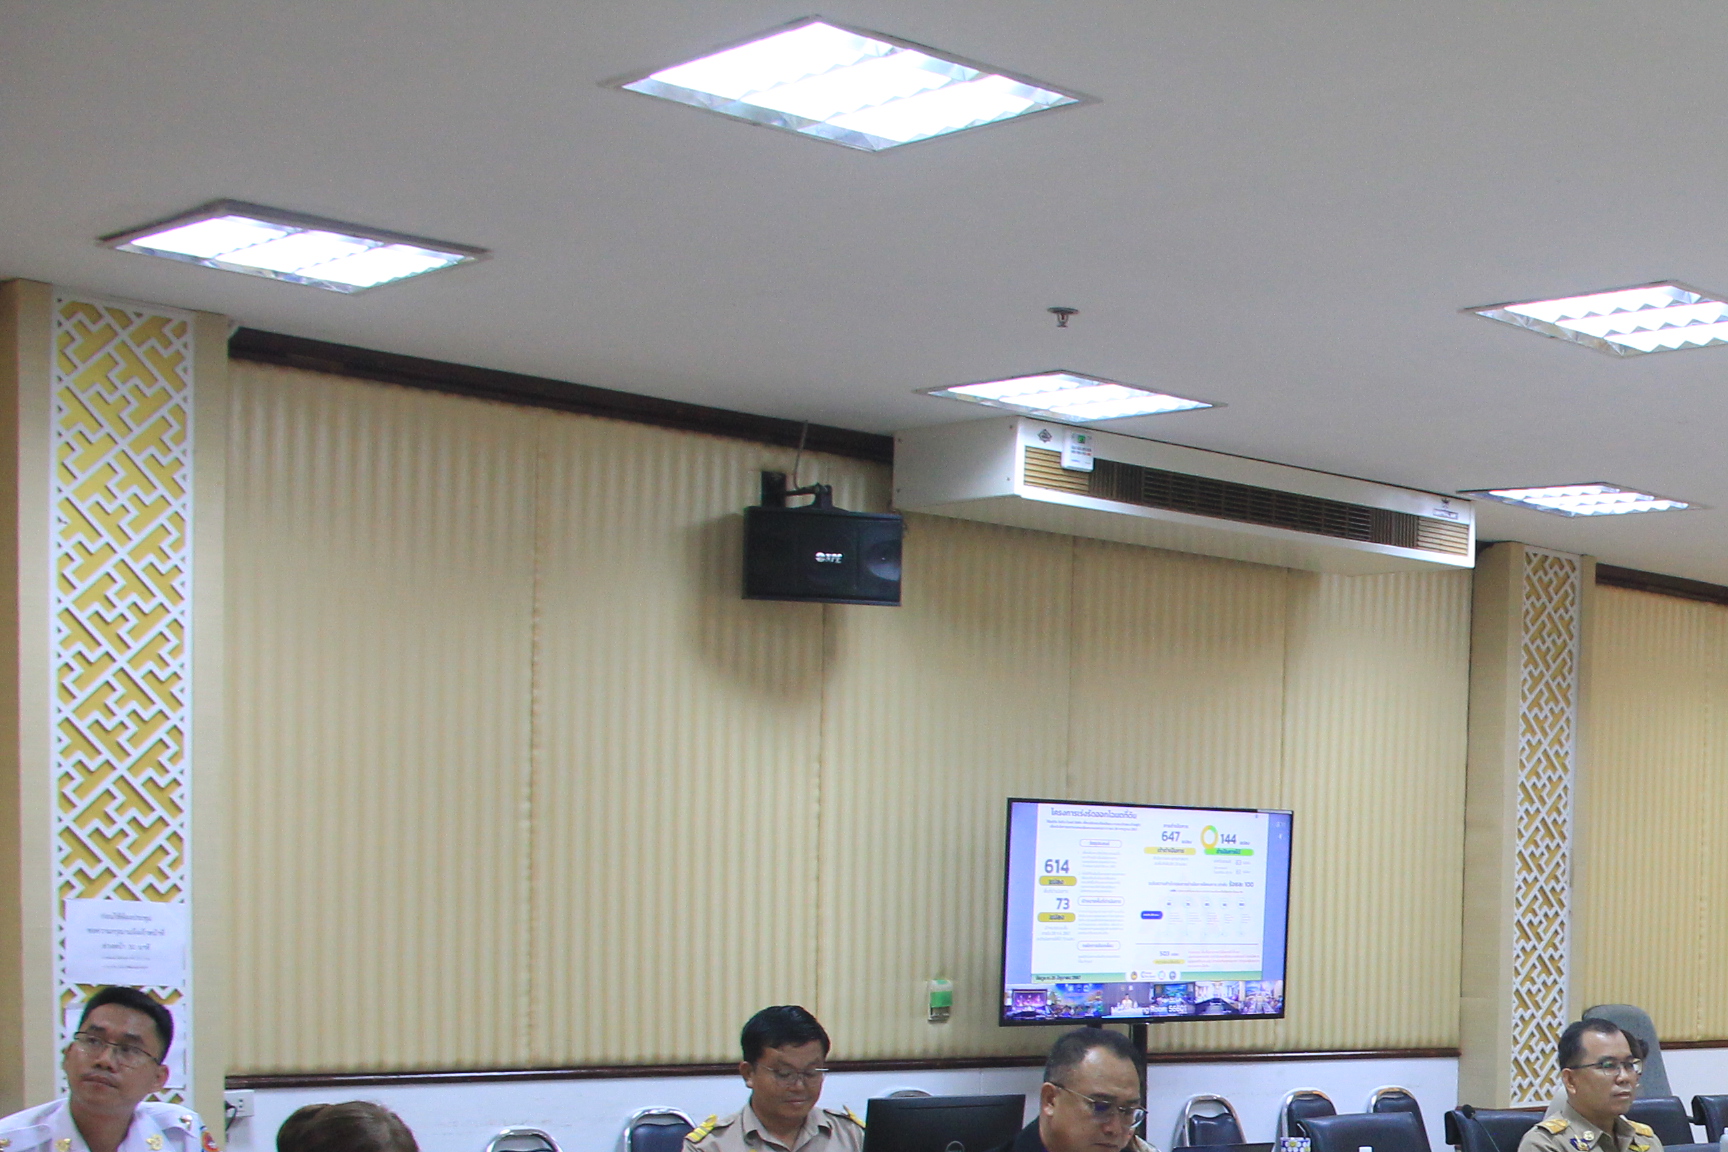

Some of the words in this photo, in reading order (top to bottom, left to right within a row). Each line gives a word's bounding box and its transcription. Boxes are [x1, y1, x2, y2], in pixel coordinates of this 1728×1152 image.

[1161, 831, 1181, 842] 647
[1220, 833, 1237, 844] 144
[1044, 858, 1070, 875] 614
[1056, 897, 1070, 910] 73
